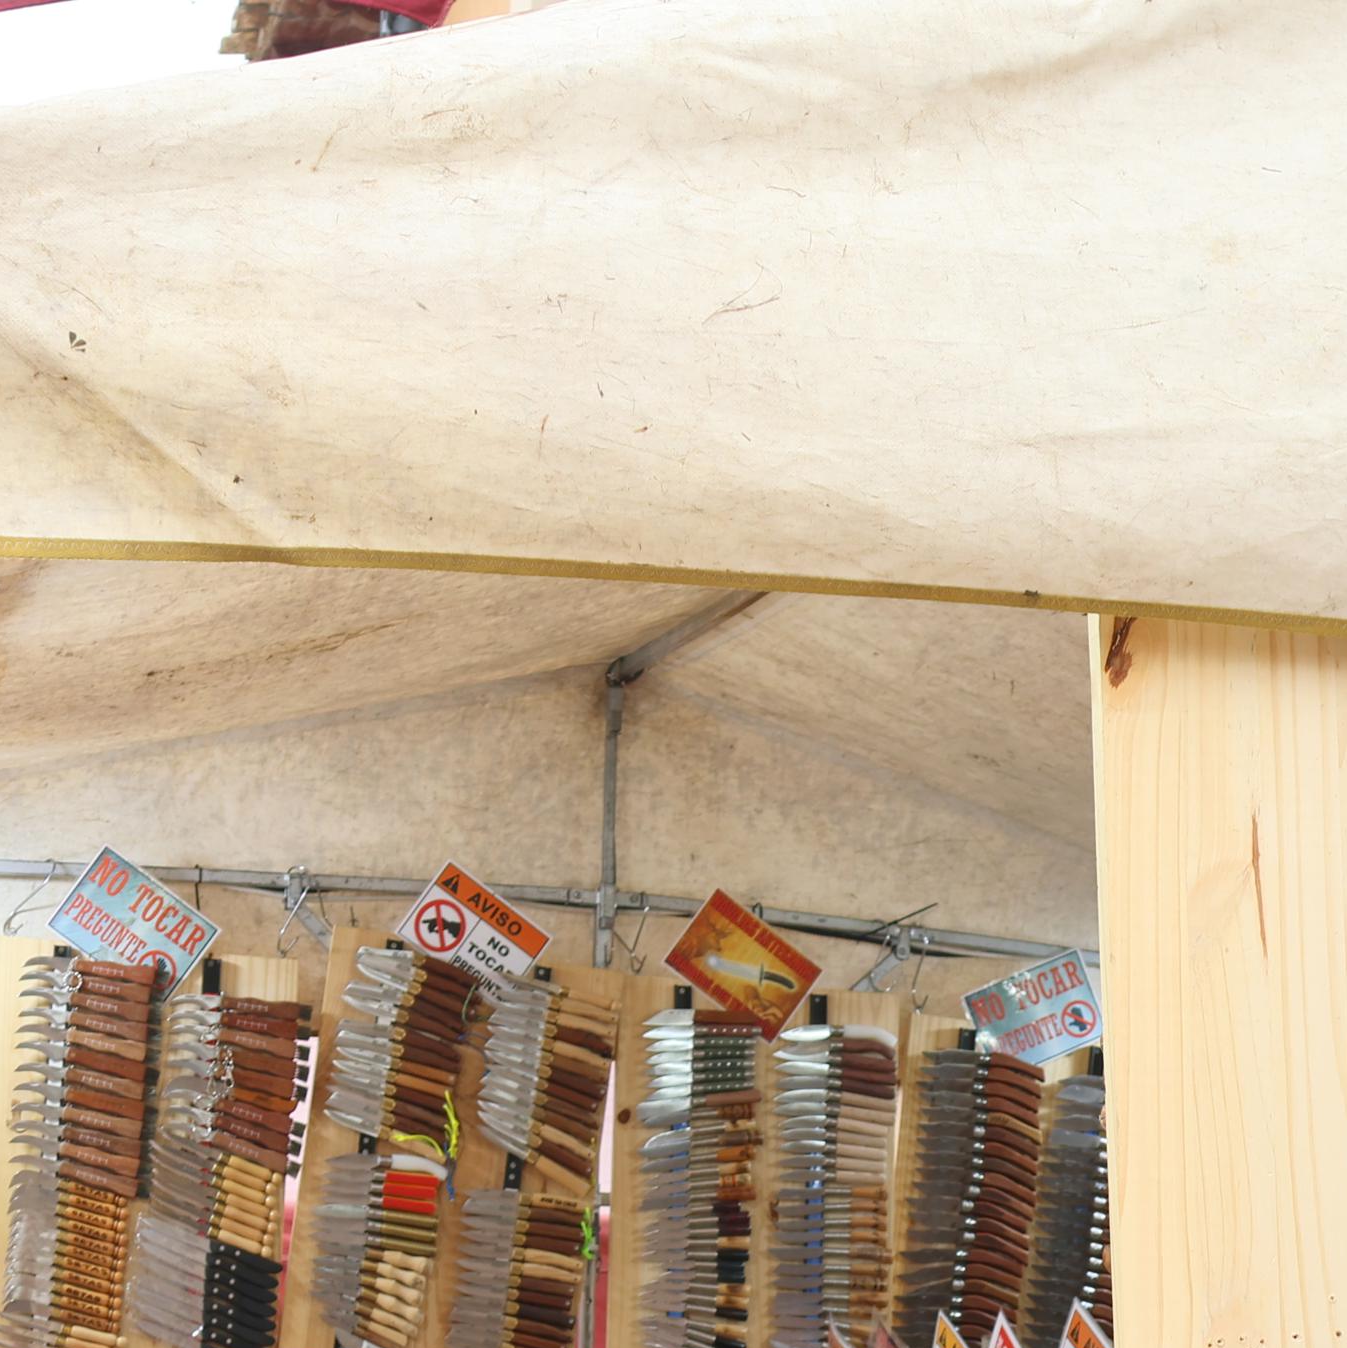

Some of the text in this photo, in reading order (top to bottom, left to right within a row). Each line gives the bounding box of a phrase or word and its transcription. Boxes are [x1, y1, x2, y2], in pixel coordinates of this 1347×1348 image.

[89, 856, 206, 956] NO TOCAR
[468, 892, 522, 936] AVISO
[64, 893, 147, 964] PREGUNTE
[487, 937, 510, 957] NO
[972, 992, 1005, 1027] NO
